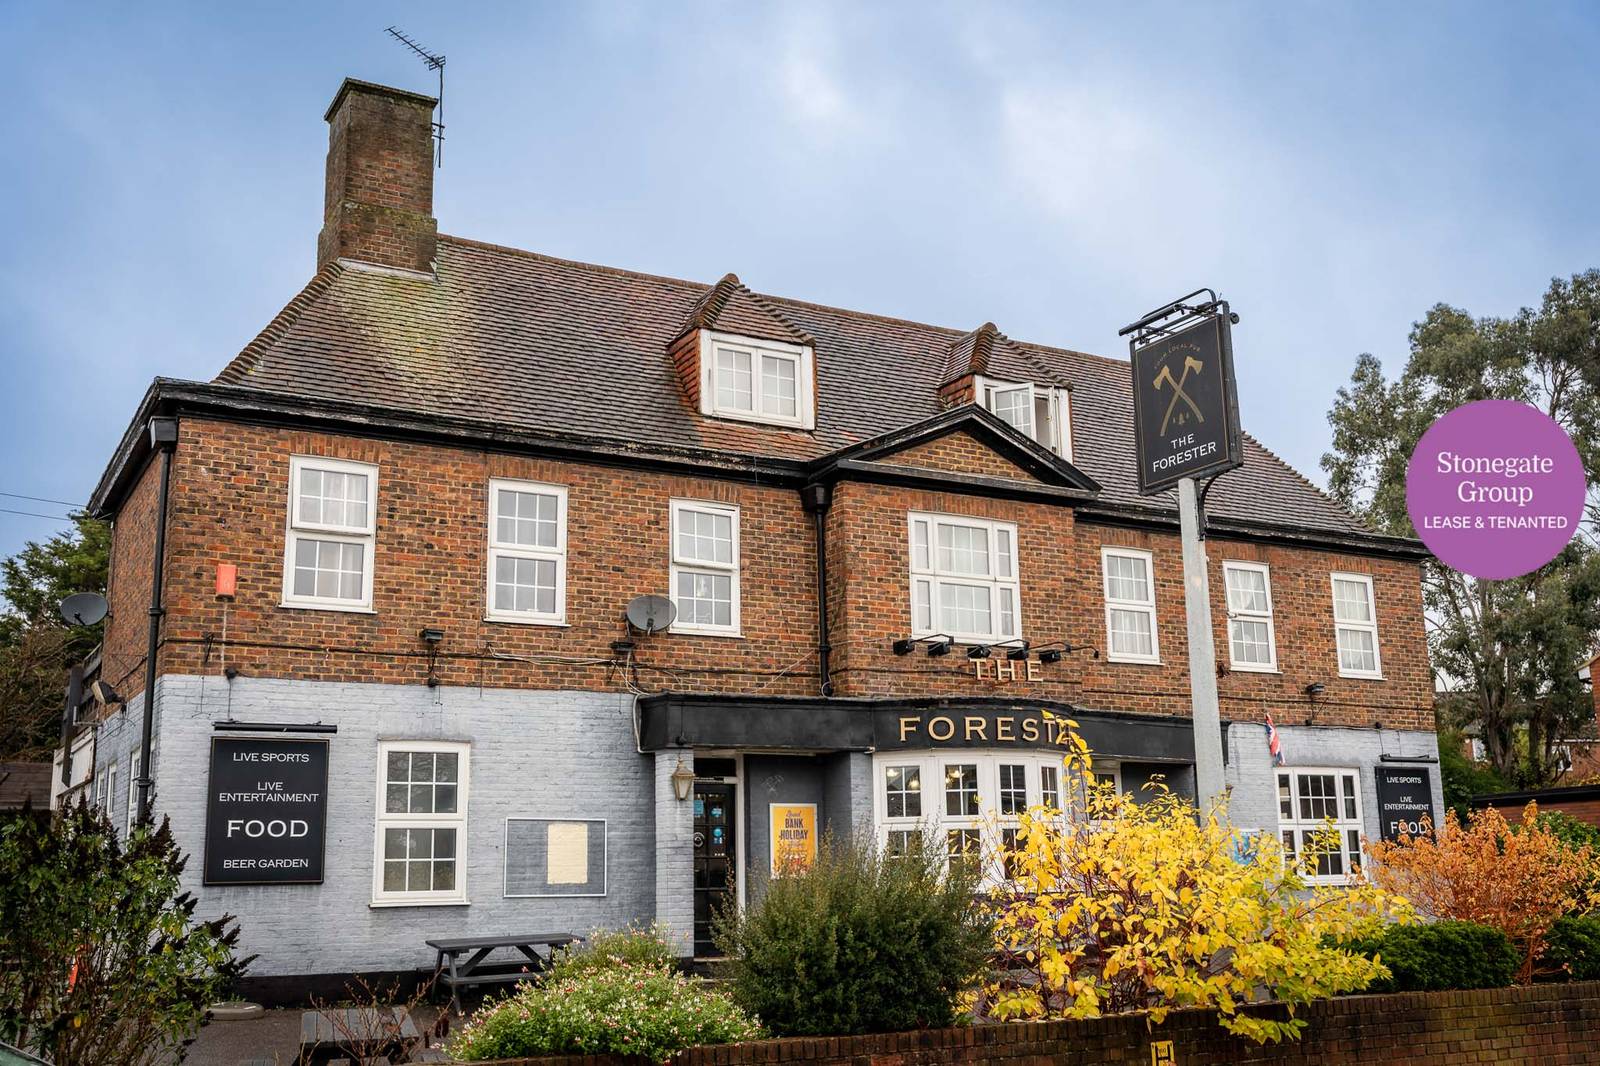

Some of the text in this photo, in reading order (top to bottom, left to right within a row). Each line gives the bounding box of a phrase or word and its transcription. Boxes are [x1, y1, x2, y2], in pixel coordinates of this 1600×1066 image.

[1171, 433, 1195, 449] THE
[1153, 441, 1216, 473] FORESTER
[969, 657, 1044, 682] THE
[899, 716, 1074, 745] FOREST
[233, 752, 310, 763] LIVE SPORTS
[1386, 776, 1422, 784] LIVE SPORTS
[257, 781, 284, 791] LIVE
[219, 792, 319, 802] ENTERTAINMENT
[1384, 803, 1430, 811] ENTERTAINMENT
[227, 819, 309, 838] FOOD
[785, 818, 804, 828] BANK
[1390, 821, 1428, 834] FOOD
[780, 829, 808, 840] HOLIDAY
[223, 858, 309, 869] BEER GARDEN
